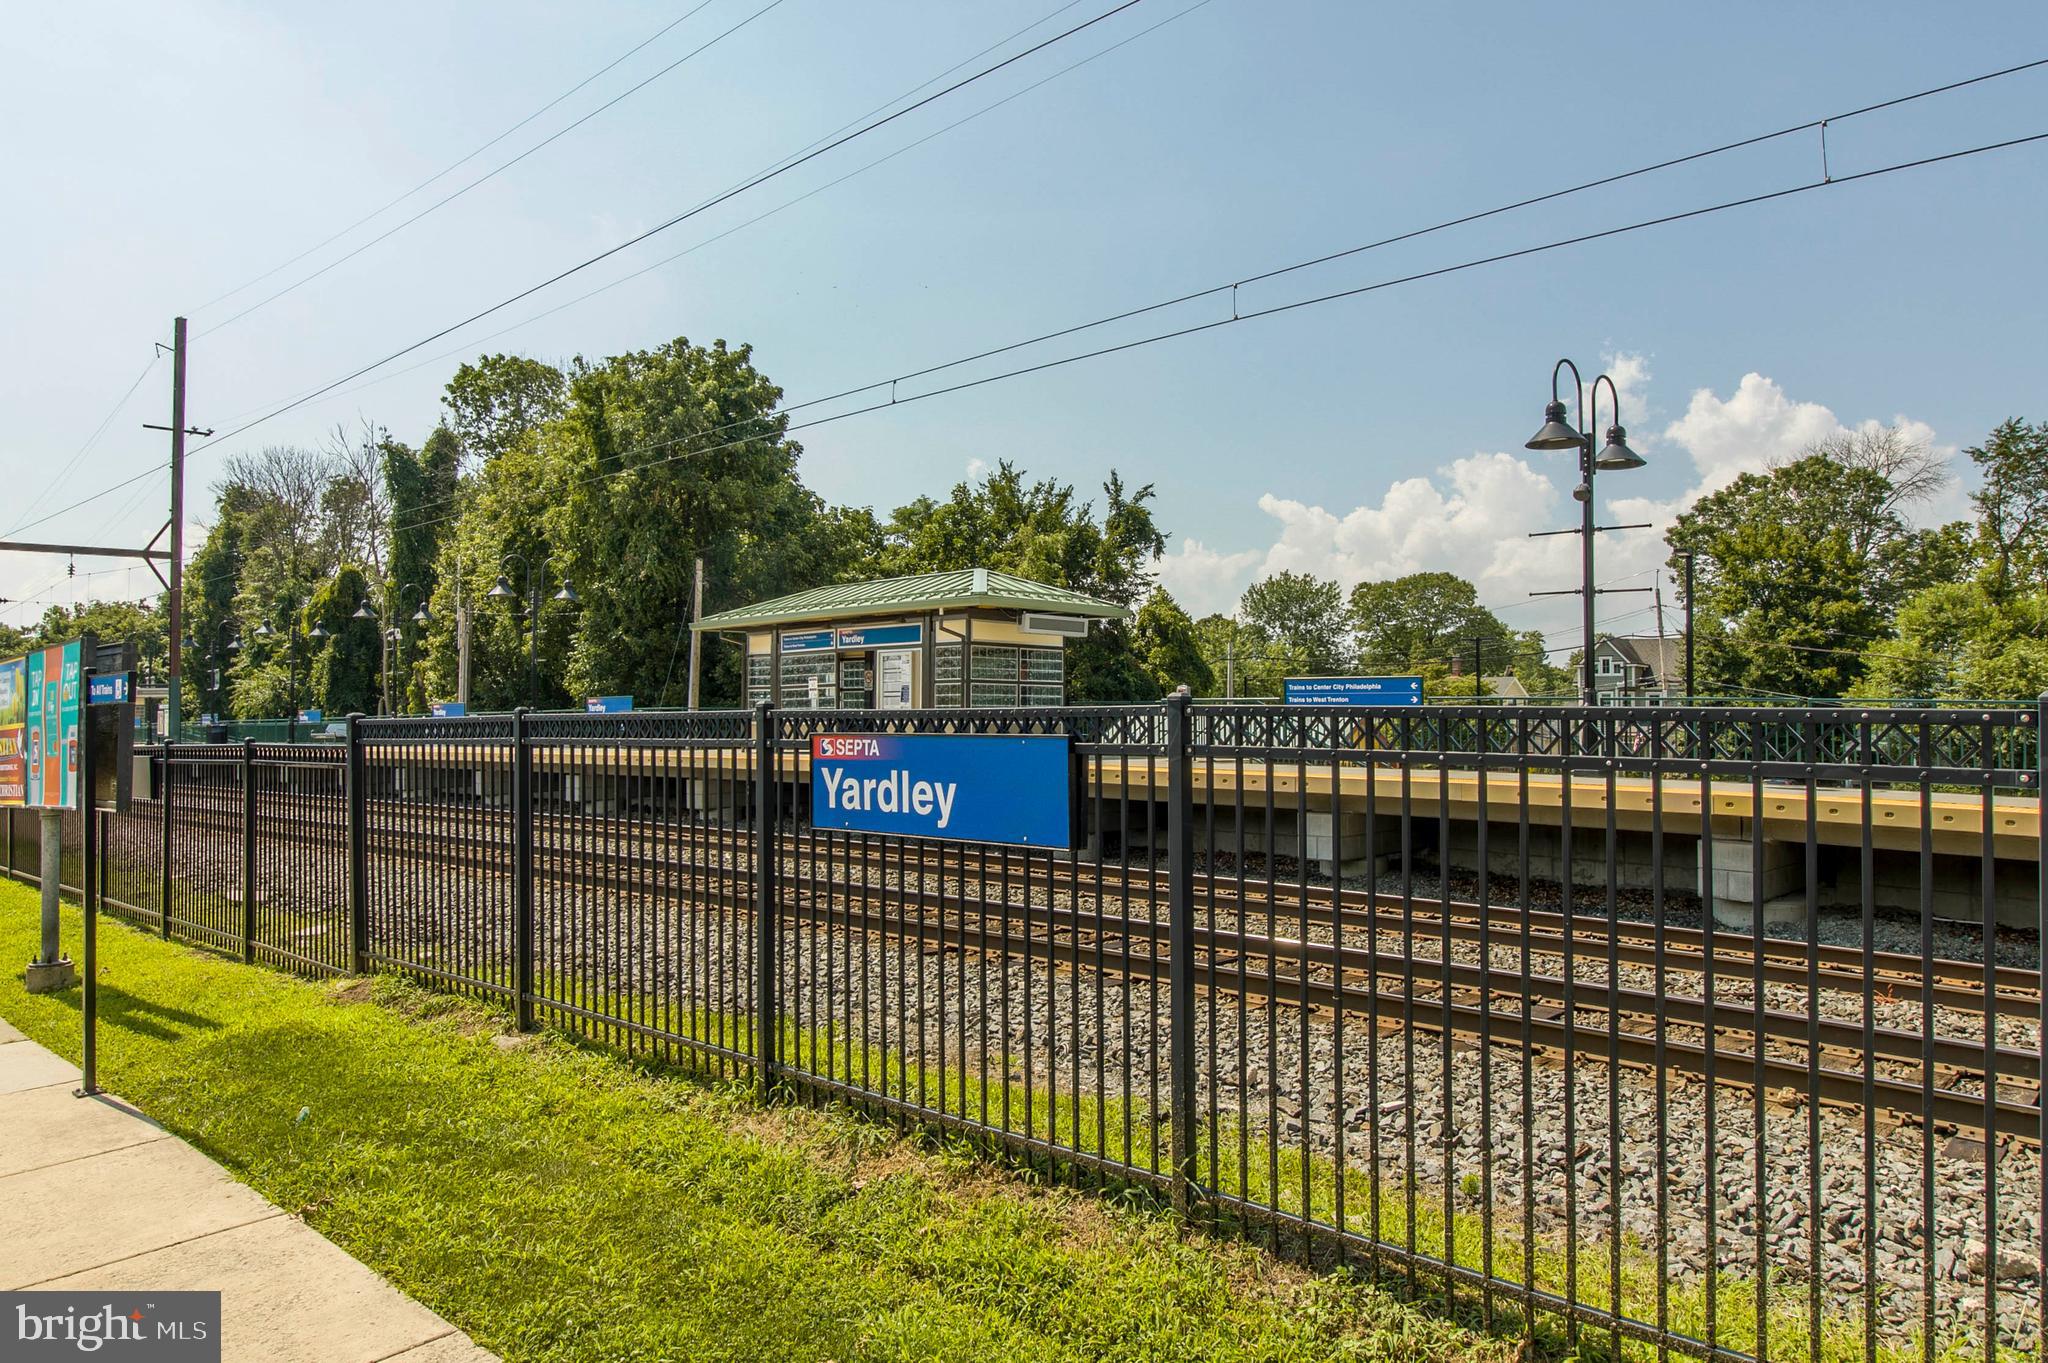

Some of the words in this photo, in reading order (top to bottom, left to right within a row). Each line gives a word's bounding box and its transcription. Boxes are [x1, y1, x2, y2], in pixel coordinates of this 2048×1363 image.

[842, 635, 864, 644] Yardley
[836, 738, 880, 756] SEPTA
[820, 767, 957, 829] Yardley
